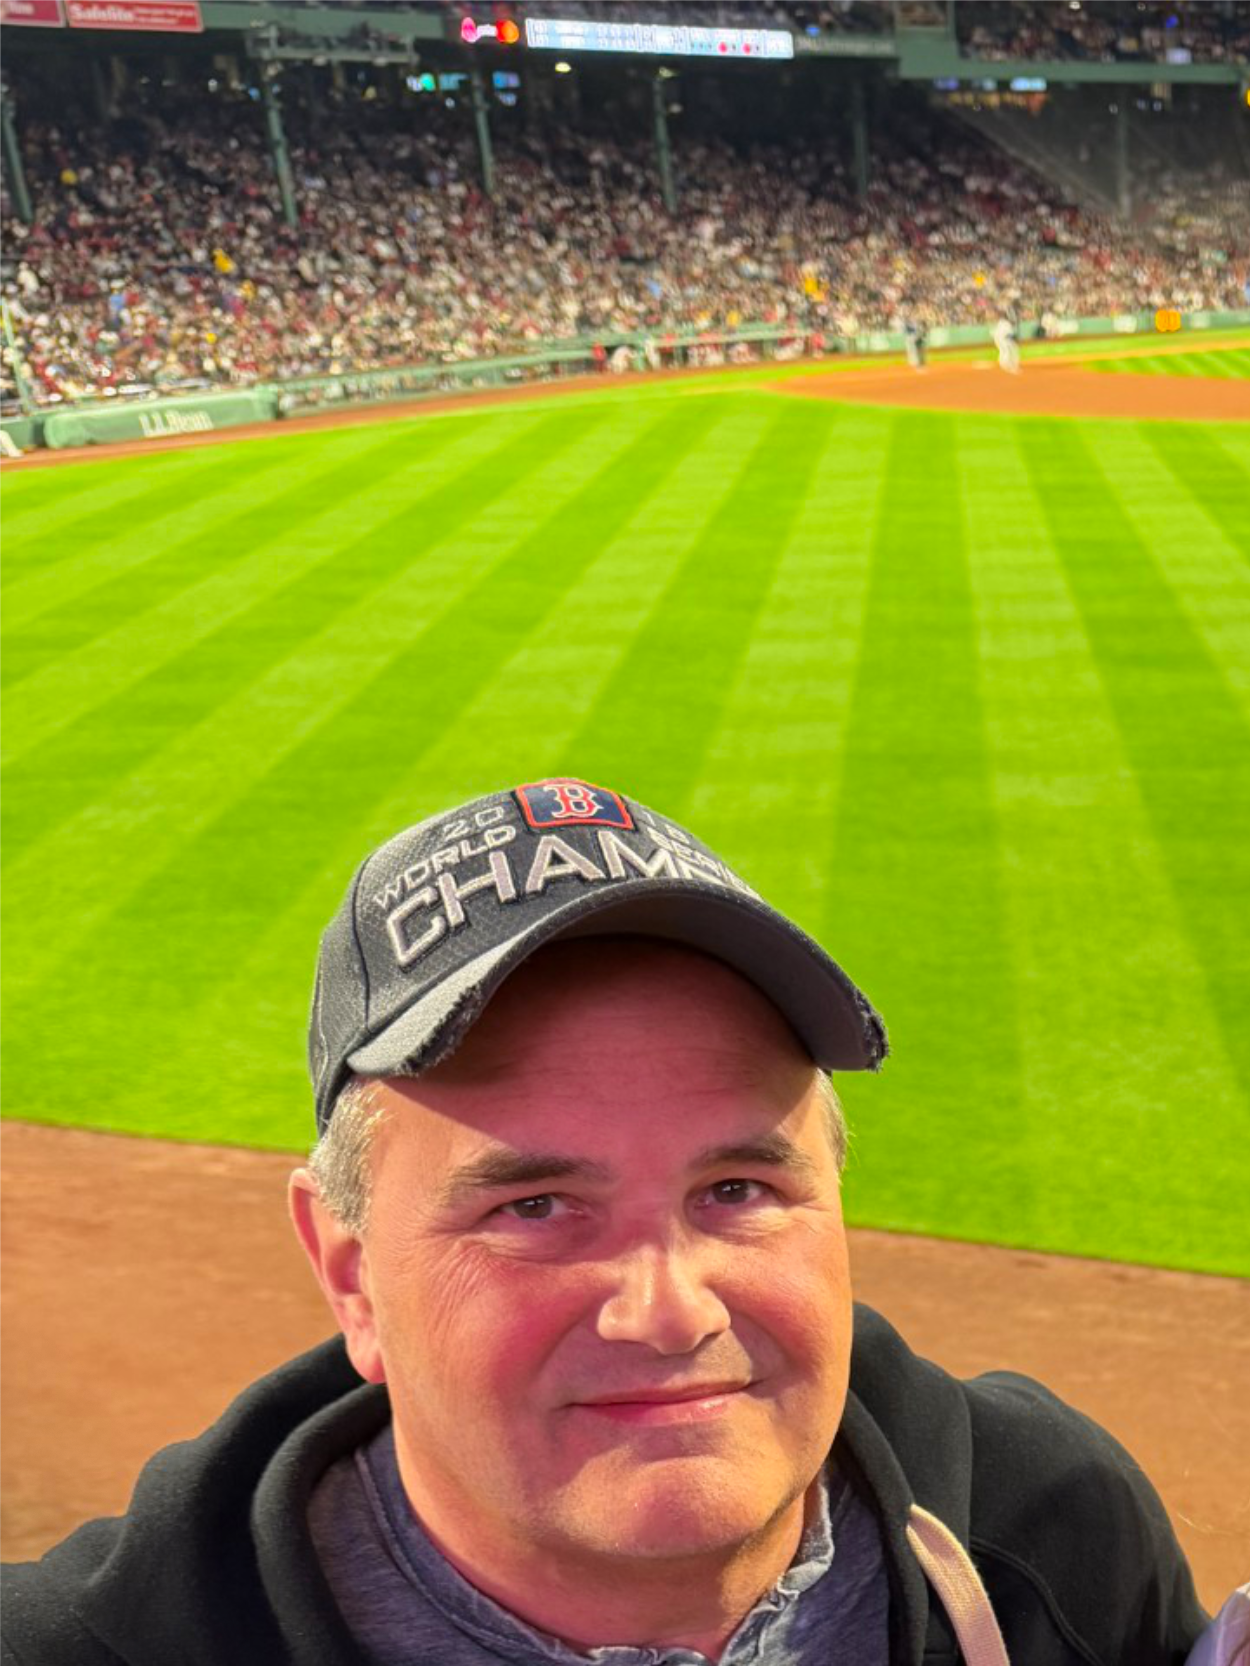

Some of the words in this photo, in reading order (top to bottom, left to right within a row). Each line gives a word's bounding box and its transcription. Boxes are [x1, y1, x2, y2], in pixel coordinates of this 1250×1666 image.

[543, 783, 604, 819] B
[442, 805, 505, 841] 20
[374, 825, 517, 911] WORLD
